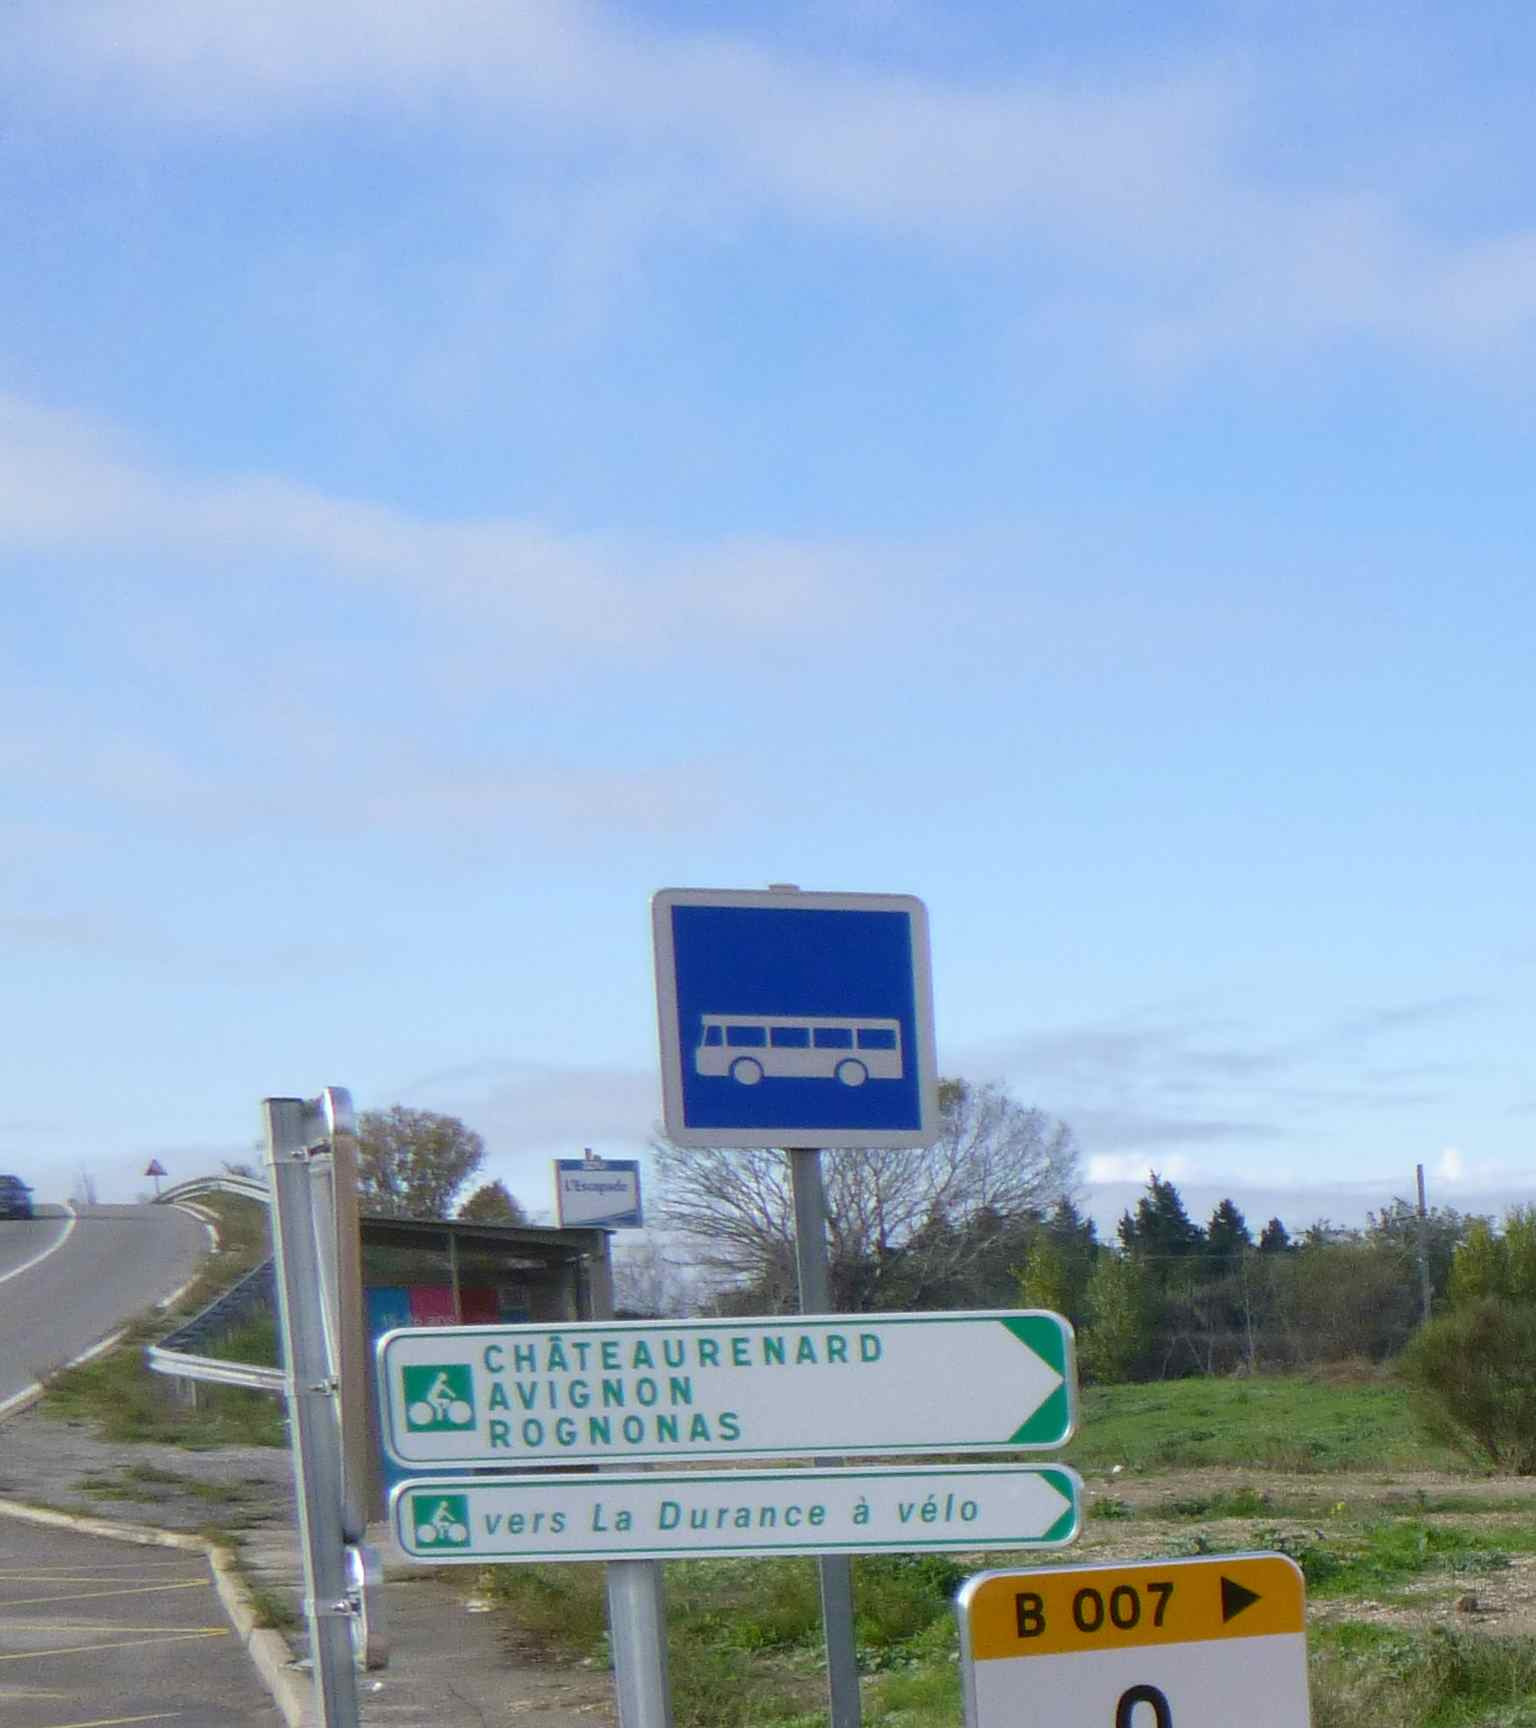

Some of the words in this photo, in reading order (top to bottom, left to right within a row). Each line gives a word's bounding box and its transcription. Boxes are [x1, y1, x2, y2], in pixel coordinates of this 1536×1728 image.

[484, 1334, 882, 1373] CHÂTEAURENARD
[488, 1375, 693, 1411] AVIGNON
[489, 1412, 741, 1448] ROGNONAS
[485, 1511, 567, 1535] vers
[592, 1503, 633, 1532] La
[659, 1500, 825, 1530] Durance
[853, 1496, 870, 1524] à
[898, 1494, 978, 1523] vélo
[1015, 1593, 1046, 1638] B
[1072, 1582, 1174, 1632] 007
